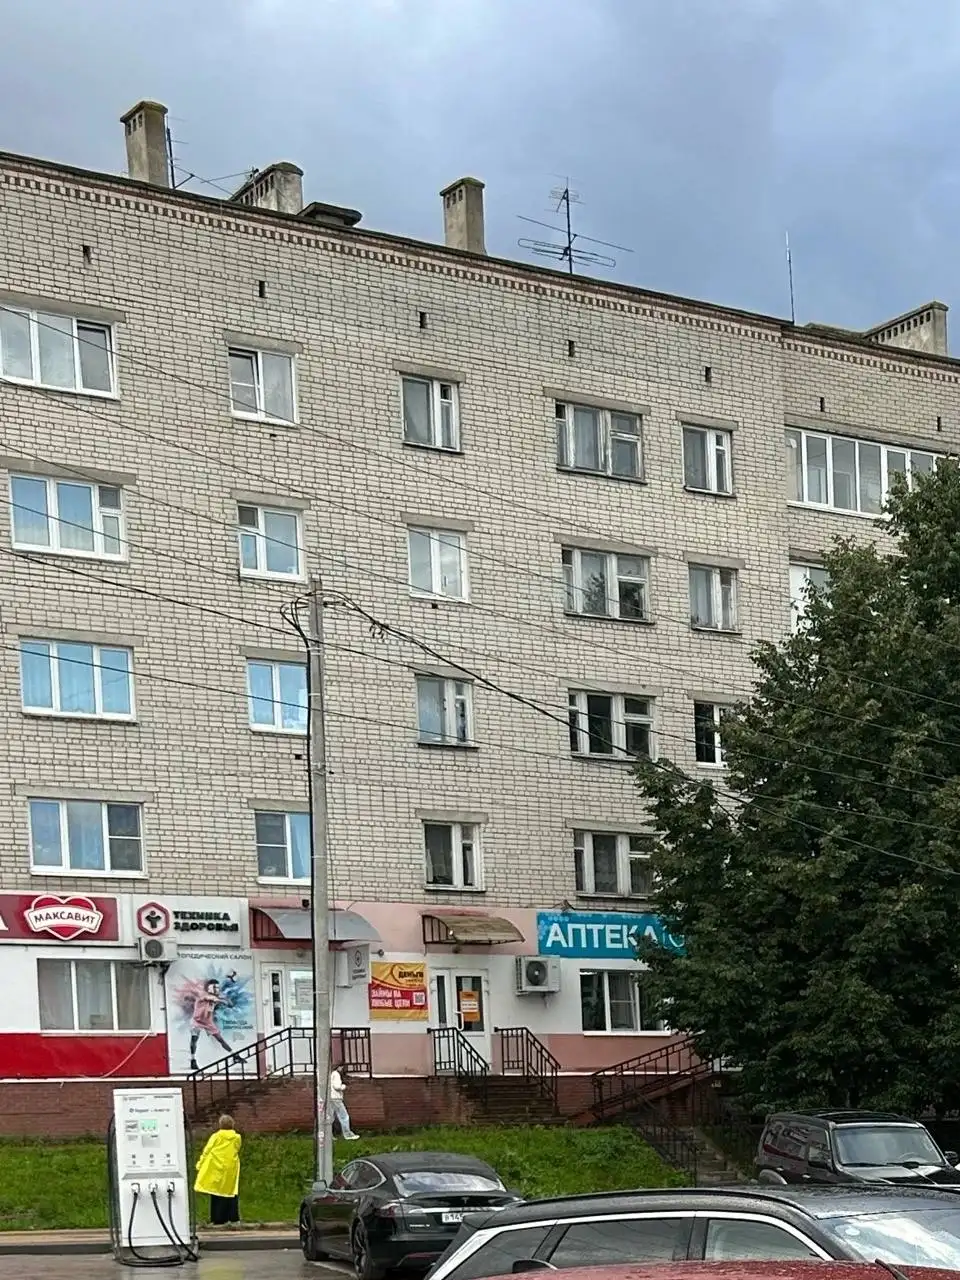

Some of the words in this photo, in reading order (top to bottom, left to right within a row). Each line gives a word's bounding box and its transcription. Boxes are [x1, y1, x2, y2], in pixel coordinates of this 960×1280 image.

[34, 910, 95, 925] МАКСАВИТ
[173, 911, 231, 921] ТЕХНИКА
[173, 921, 239, 931] ЗДОРОВЬЯ
